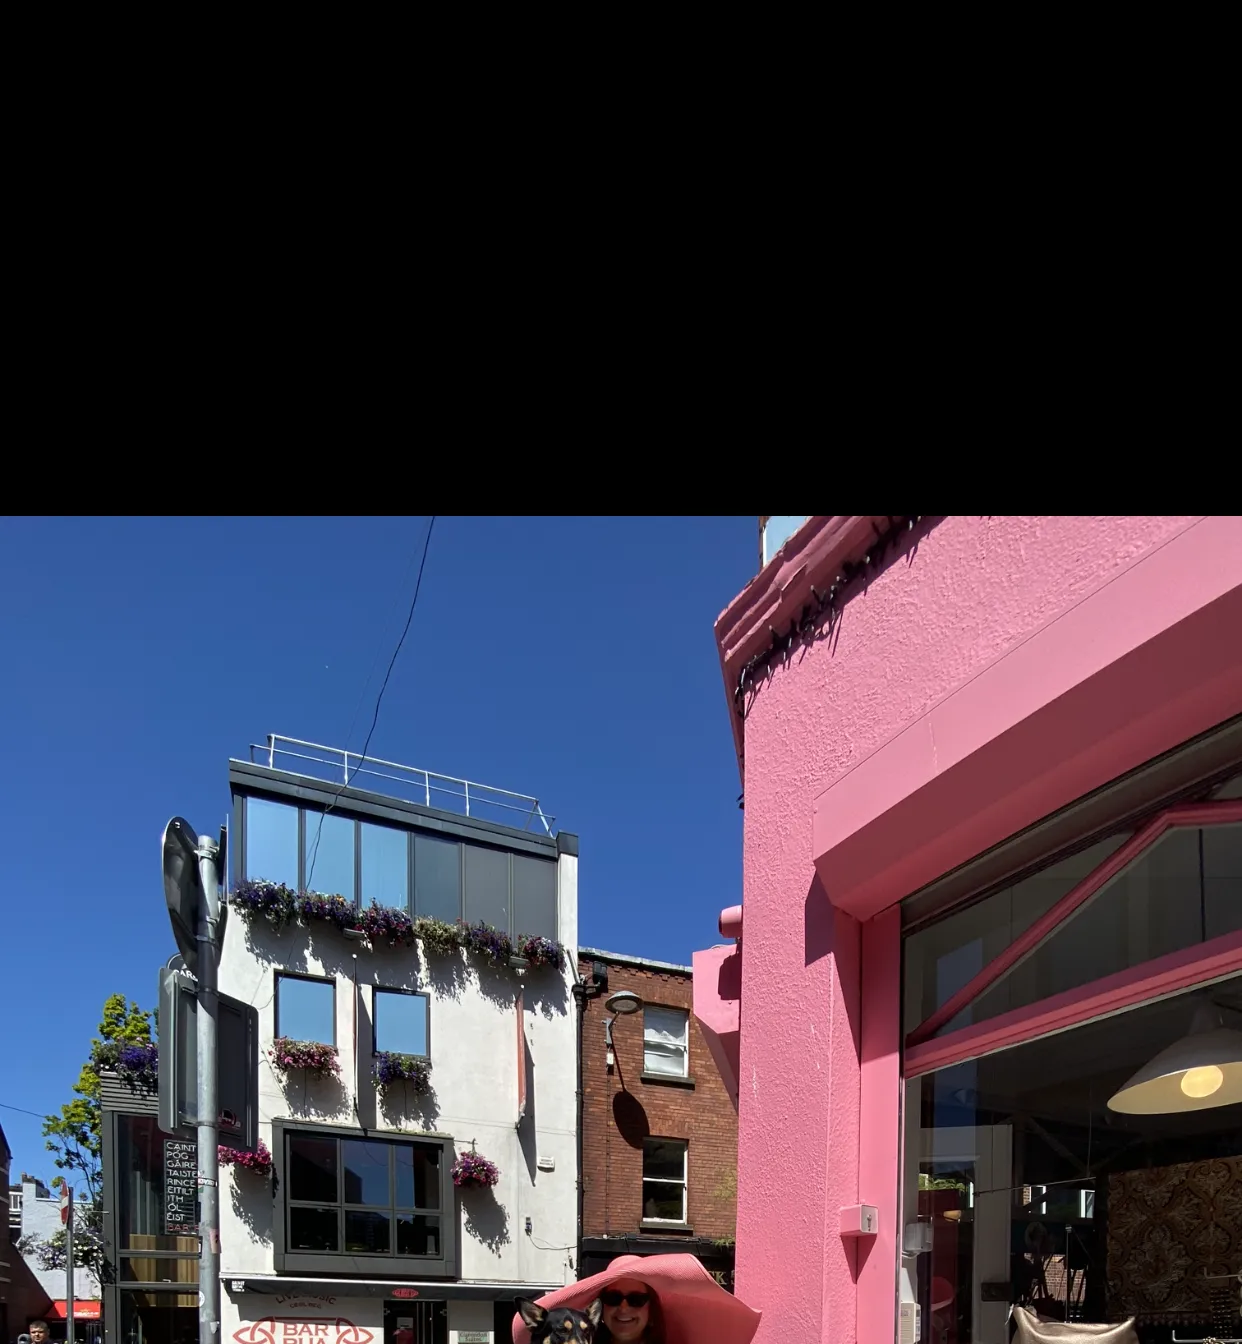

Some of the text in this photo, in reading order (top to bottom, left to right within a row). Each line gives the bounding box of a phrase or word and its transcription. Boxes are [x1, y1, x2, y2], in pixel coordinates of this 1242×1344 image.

[166, 1142, 196, 1152] CAINT
[166, 1150, 188, 1160] PÓG
[167, 1160, 196, 1169] GÁIRE
[168, 1169, 198, 1178] TAISTE
[167, 1178, 195, 1187] RINCE
[168, 1187, 194, 1195] EITILT
[167, 1195, 184, 1203] ITH
[167, 1224, 189, 1232] BAR
[283, 1323, 330, 1336] BAR
